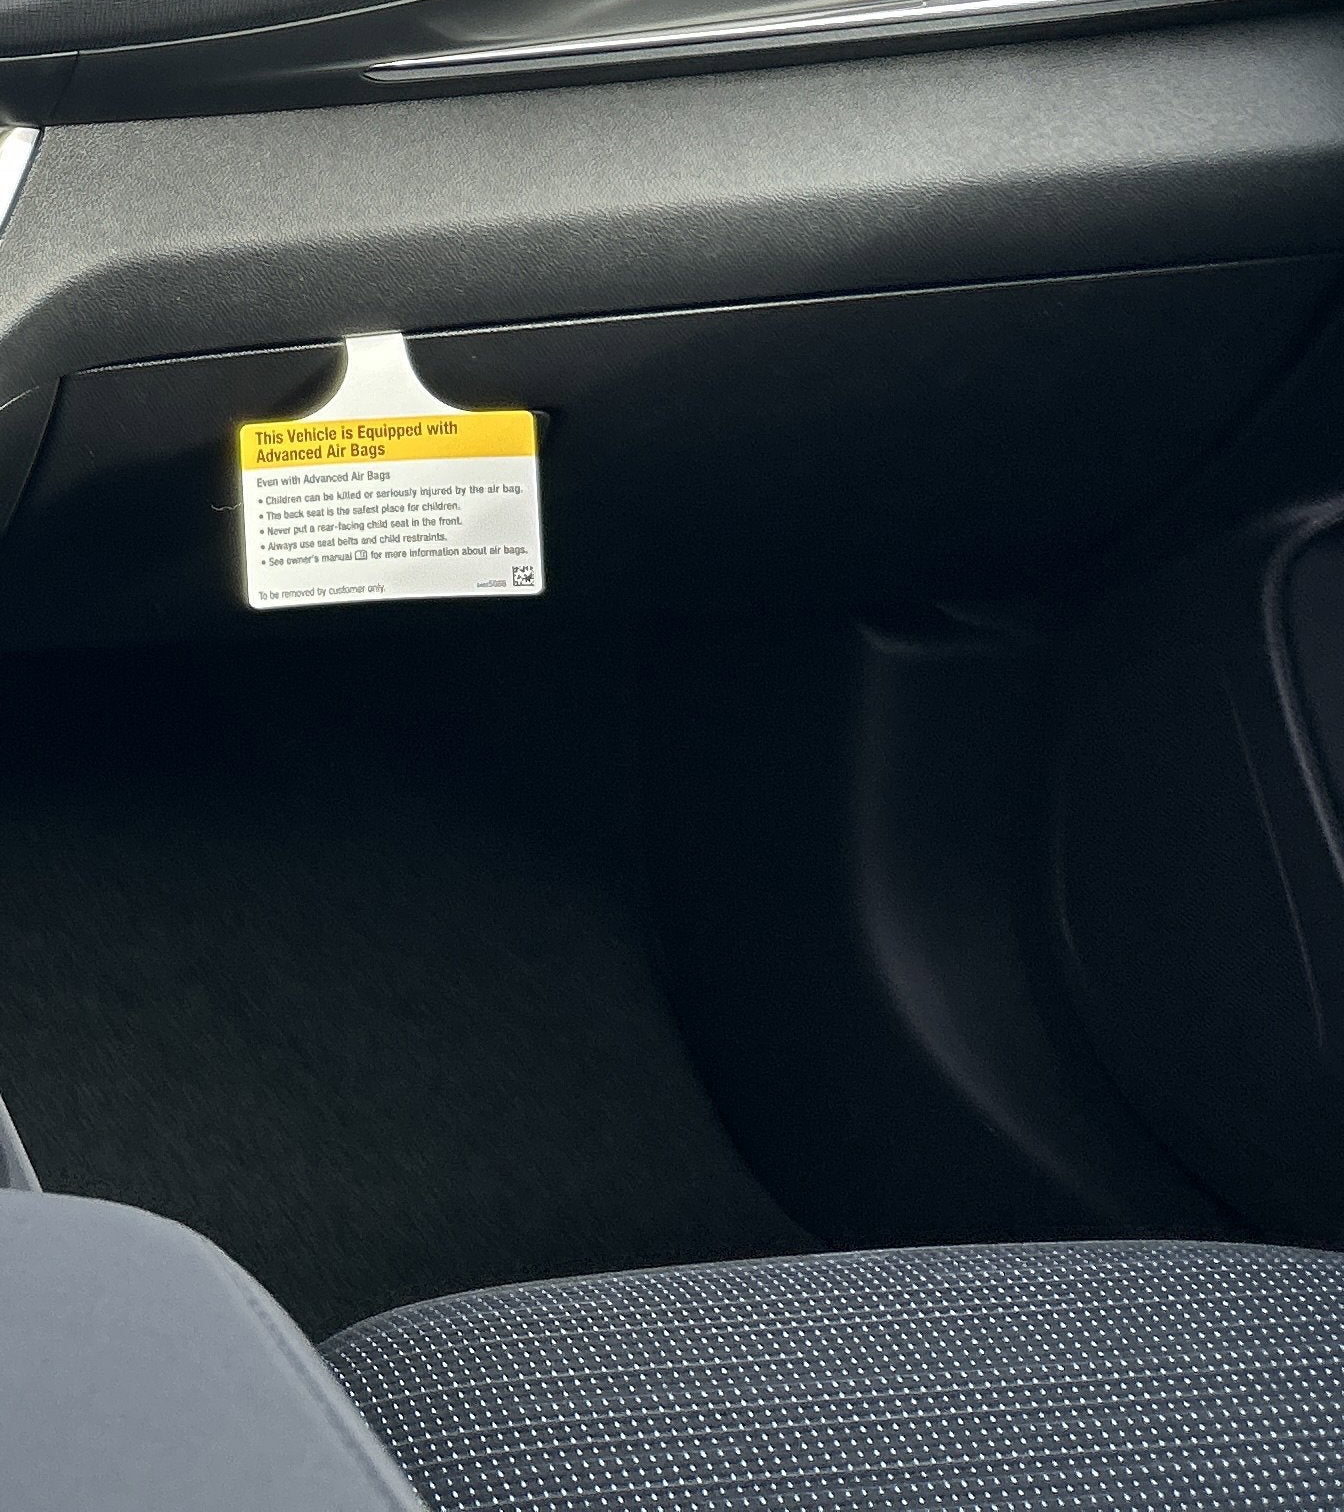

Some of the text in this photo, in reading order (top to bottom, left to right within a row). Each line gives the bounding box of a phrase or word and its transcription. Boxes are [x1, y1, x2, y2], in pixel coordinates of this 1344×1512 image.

[256, 420, 458, 445] This Vehicle is Equipped with
[256, 443, 386, 463] Advanced Air Bags
[257, 470, 391, 488] Even with Advanced Air Bags
[265, 484, 523, 505] Children can be killed or seriously injured by the air bag.
[266, 502, 461, 520] The back seat is the safest place for children.
[267, 526, 291, 536] Never
[293, 525, 308, 536] put
[317, 521, 365, 532] rear-facing
[367, 519, 388, 529] child
[390, 518, 409, 528] seat
[411, 517, 419, 527] in
[422, 516, 436, 527] the
[439, 516, 462, 526] front.
[268, 533, 447, 552] Always use seat belts and child restraints.
[269, 545, 529, 567] See owner's manual for more information about air bags.
[258, 582, 387, 601] To be removed by customer only.
